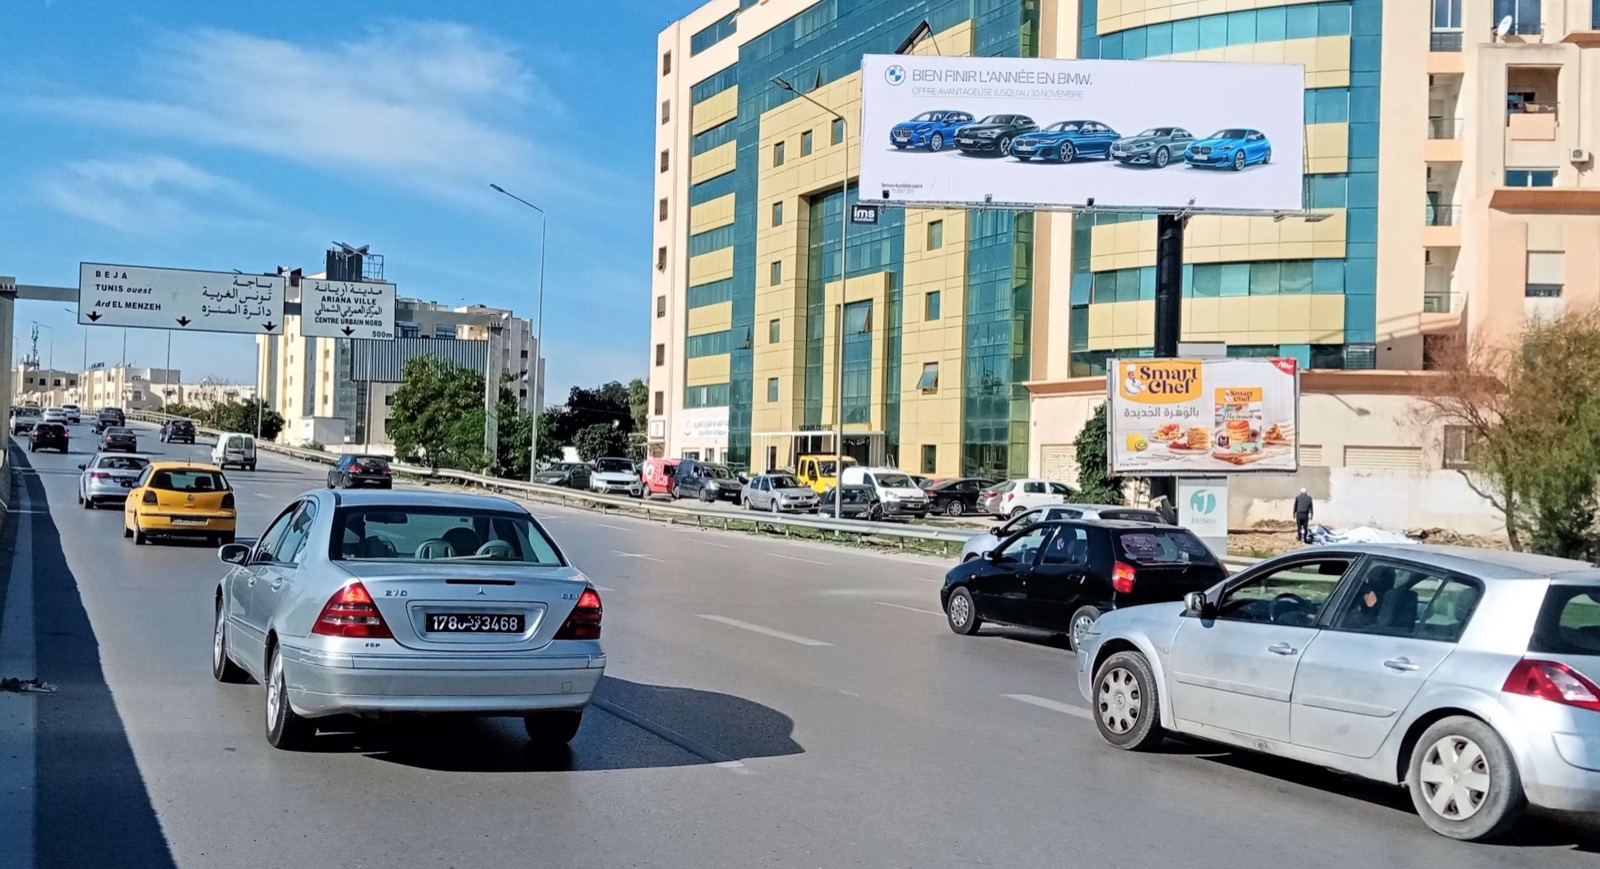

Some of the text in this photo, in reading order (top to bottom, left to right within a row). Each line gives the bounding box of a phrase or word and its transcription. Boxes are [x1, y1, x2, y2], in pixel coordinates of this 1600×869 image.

[912, 69, 1093, 85] BIEN FINIR L'ANNÉE EN BMW.
[912, 87, 937, 95] OFFRE
[938, 87, 993, 97] AVANTAGEUSE
[1030, 89, 1040, 97] 30
[1041, 90, 1084, 98] NOVEMBRE
[854, 206, 875, 218] ims
[95, 270, 128, 279] BEJA
[95, 283, 123, 292] TUNIS
[233, 276, 273, 291] باجة
[314, 281, 383, 297] مدينة أريانة
[202, 286, 272, 304] تونس الغربية
[321, 296, 352, 304] ARIANA
[125, 301, 161, 310] MENZEH
[243, 305, 272, 319] دائرة
[314, 303, 383, 318] المركز العمراني الشمالي
[340, 318, 364, 326] URBAIN
[365, 319, 383, 327] NORD
[1140, 366, 1198, 382] Smart
[1148, 378, 1194, 394] Chef
[432, 615, 518, 631] 178 تونس 3468
